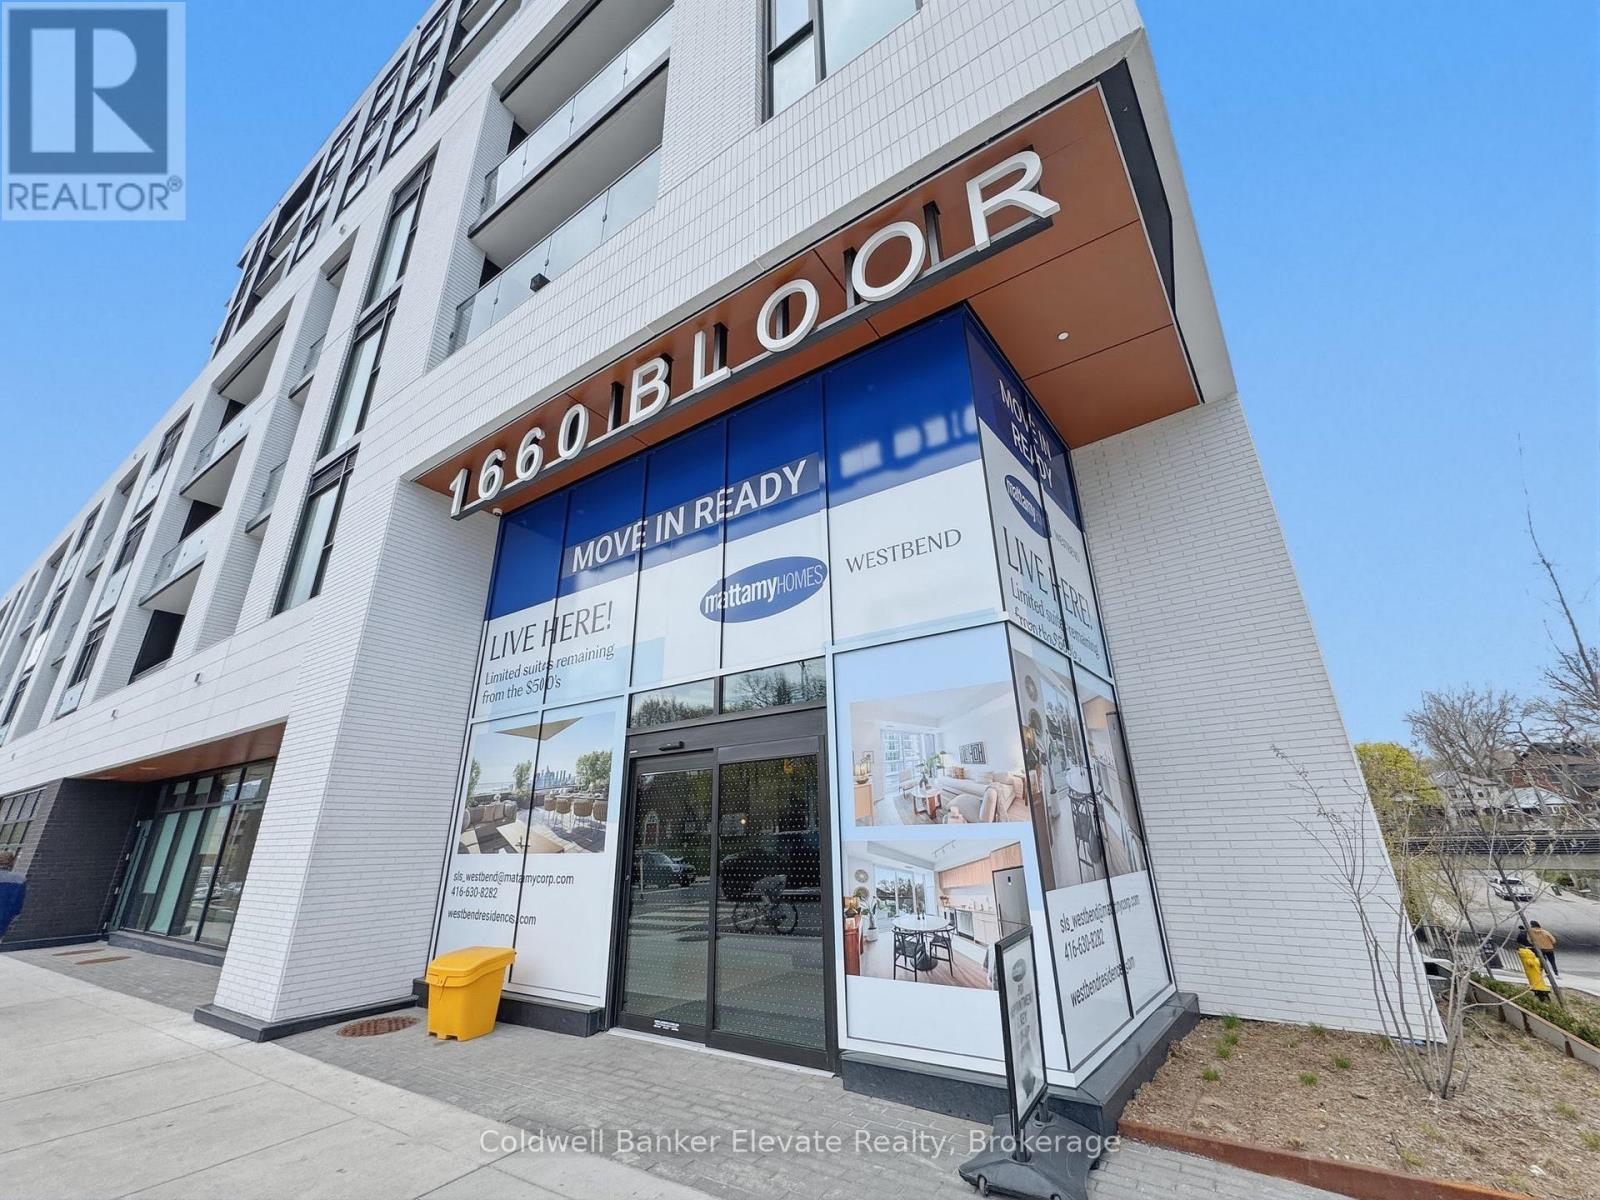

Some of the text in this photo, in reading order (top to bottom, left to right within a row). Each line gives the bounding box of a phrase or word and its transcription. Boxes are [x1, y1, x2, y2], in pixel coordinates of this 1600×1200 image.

[449, 150, 1061, 519] 1660 BLOOR
[1011, 421, 1053, 489] READY
[571, 459, 808, 573] MOVE IN READY
[846, 528, 962, 574] WESTBEND
[1002, 526, 1048, 594] LIVE
[1010, 577, 1046, 618] Limited
[489, 600, 613, 662] LIVE HERE!
[485, 663, 521, 686] Limited
[556, 643, 616, 669] remaining
[481, 690, 505, 704] from
[507, 684, 524, 700] the
[451, 886, 498, 899] 416-630-8282
